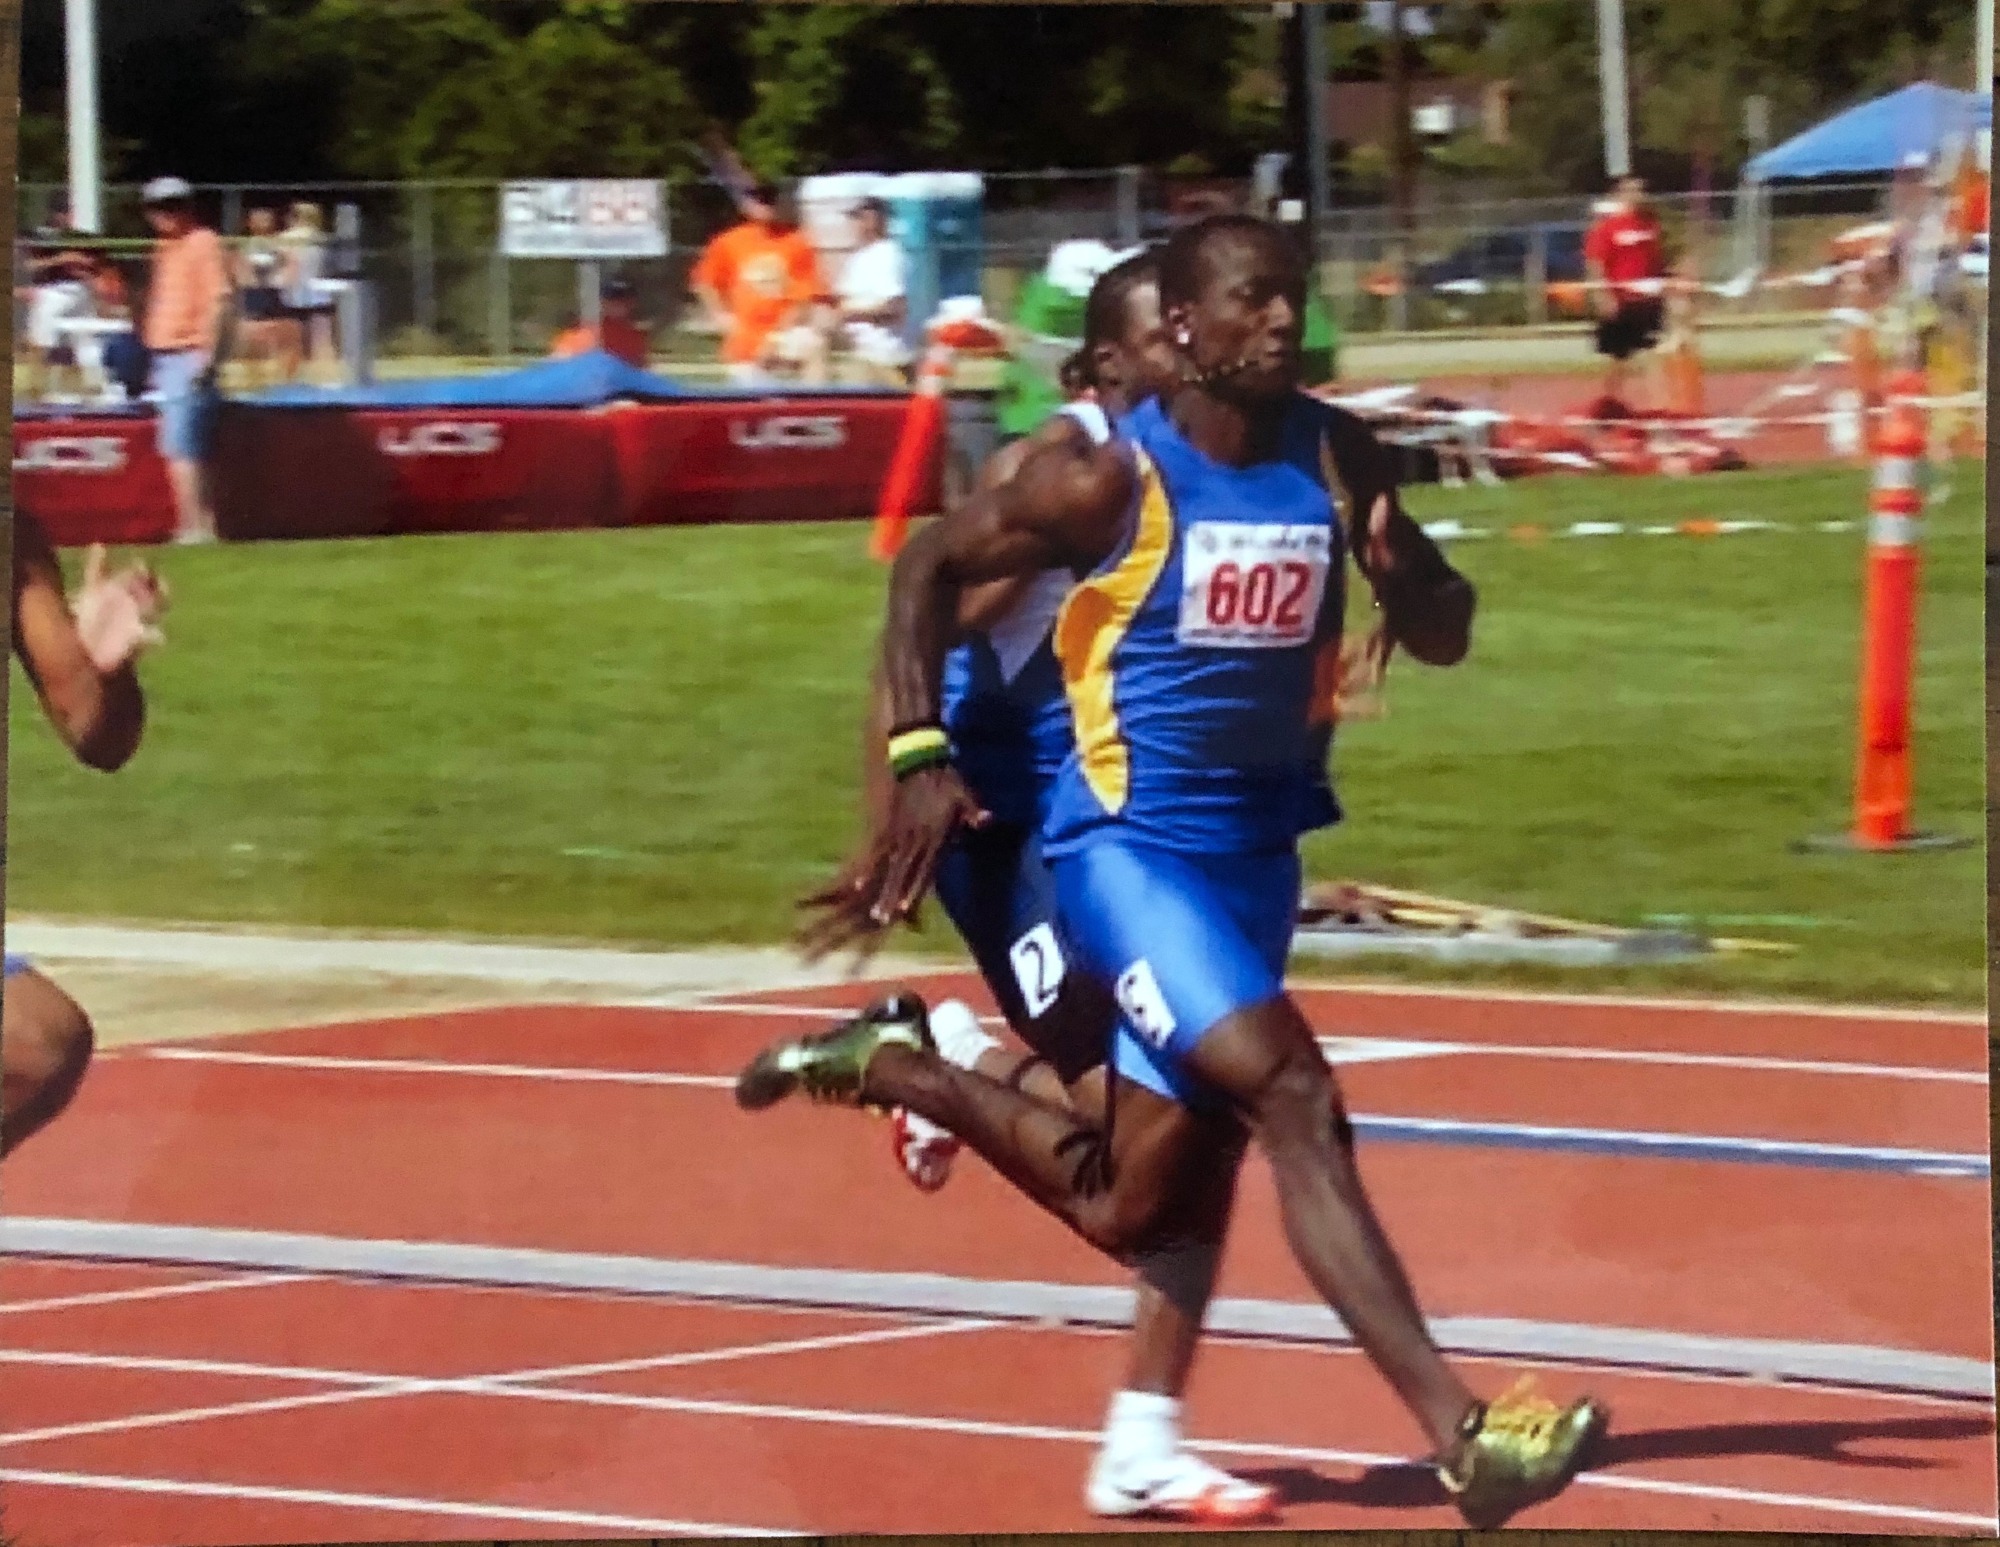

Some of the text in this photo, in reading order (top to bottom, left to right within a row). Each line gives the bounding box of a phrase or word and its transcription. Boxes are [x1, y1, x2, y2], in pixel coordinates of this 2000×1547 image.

[378, 422, 503, 455] UCS
[727, 416, 848, 448] UCS
[1206, 561, 1312, 627] 602
[1019, 939, 1058, 1002] 2
